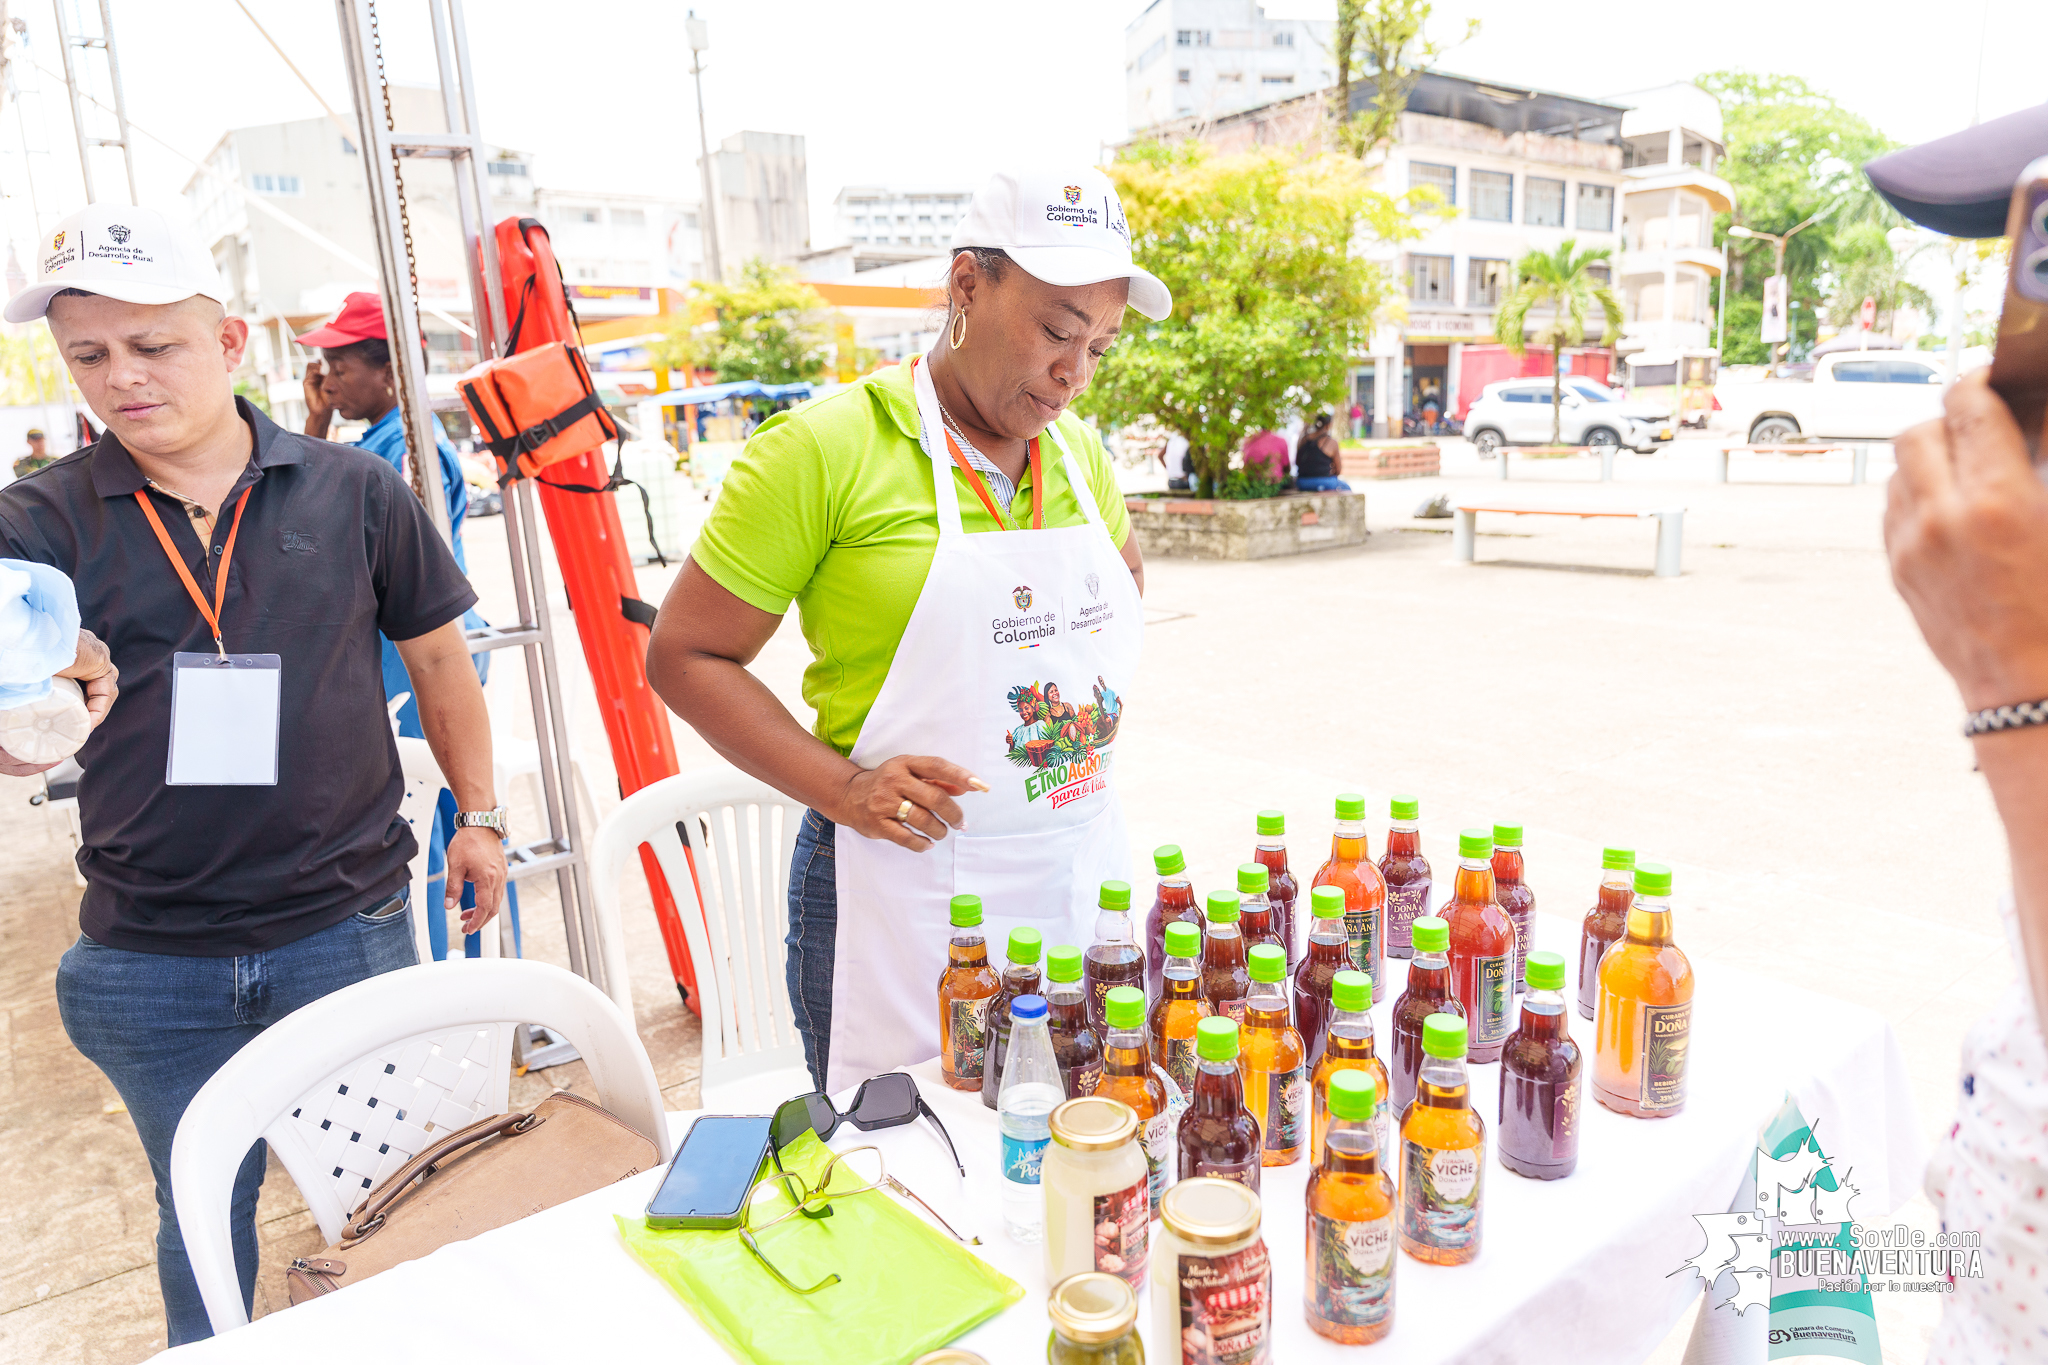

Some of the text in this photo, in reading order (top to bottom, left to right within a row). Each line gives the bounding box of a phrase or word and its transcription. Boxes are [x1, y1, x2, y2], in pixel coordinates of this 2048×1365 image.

[1046, 204, 1098, 216] Gobierno de
[1046, 212, 1098, 224] Colombia
[88, 251, 130, 260] Desarrollo
[98, 244, 131, 254] Agencia
[44, 251, 65, 266] Gobierno
[44, 254, 75, 274] Colombia
[1080, 602, 1102, 618] Agencia
[992, 611, 1056, 630] Gobierno de
[1071, 615, 1102, 630] Desarrollo
[993, 623, 1056, 645] Colombia
[1051, 787, 1080, 810] para
[1393, 902, 1418, 913] DOÑA
[1397, 912, 1416, 921] ANA
[1346, 923, 1359, 933] ÑA
[1486, 966, 1508, 979] DOÑA
[1661, 1011, 1685, 1021] CURADA
[1654, 1018, 1688, 1033] DOÑA
[1653, 1079, 1677, 1087] BEBIDA
[1148, 1124, 1167, 1140] VICH
[1436, 1162, 1473, 1176] VICHE
[1350, 1230, 1388, 1247] VICHE
[1824, 1325, 1854, 1335] Comercio
[1792, 1331, 1857, 1343] Buenaventura
